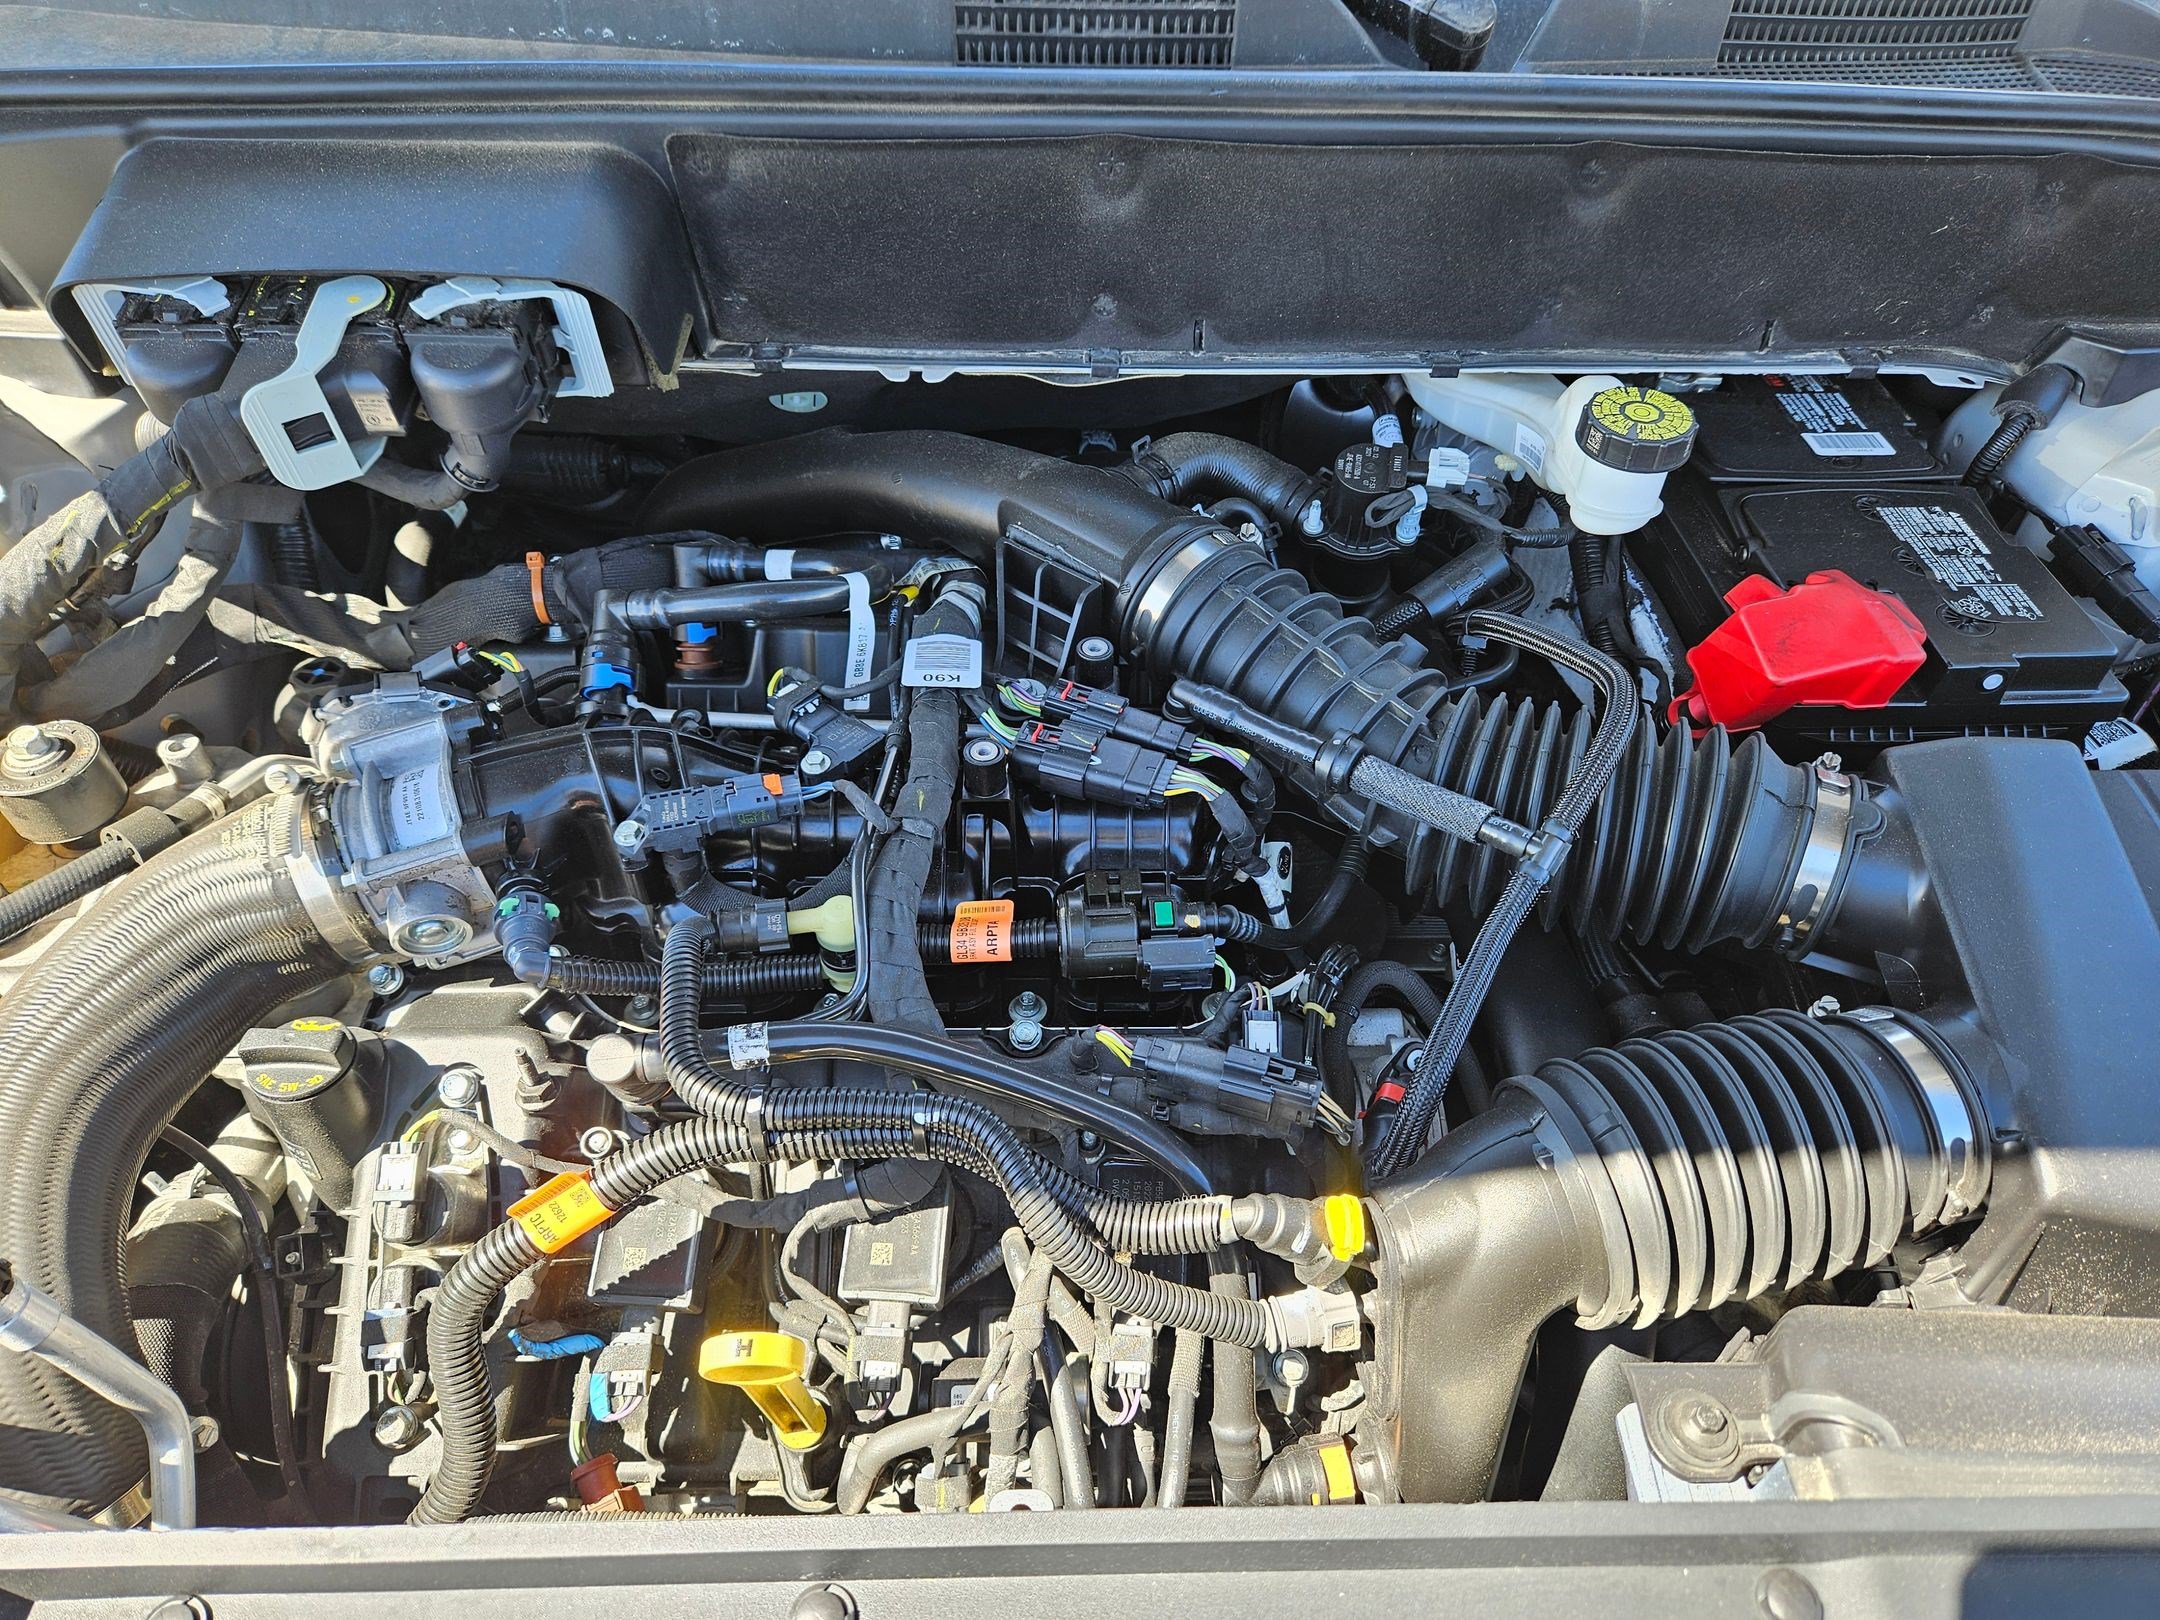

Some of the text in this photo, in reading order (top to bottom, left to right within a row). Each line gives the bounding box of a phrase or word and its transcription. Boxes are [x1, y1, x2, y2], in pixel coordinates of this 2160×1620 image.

[923, 674, 960, 682] K90
[1192, 703, 1219, 721] COOPER
[1219, 717, 1257, 737] STANDARD
[987, 920, 999, 955] ARPTA
[957, 940, 968, 959] GL34
[256, 1073, 324, 1092] SAE 5W-30
[550, 1200, 567, 1223] 12622
[530, 1213, 560, 1243] ARPTC
